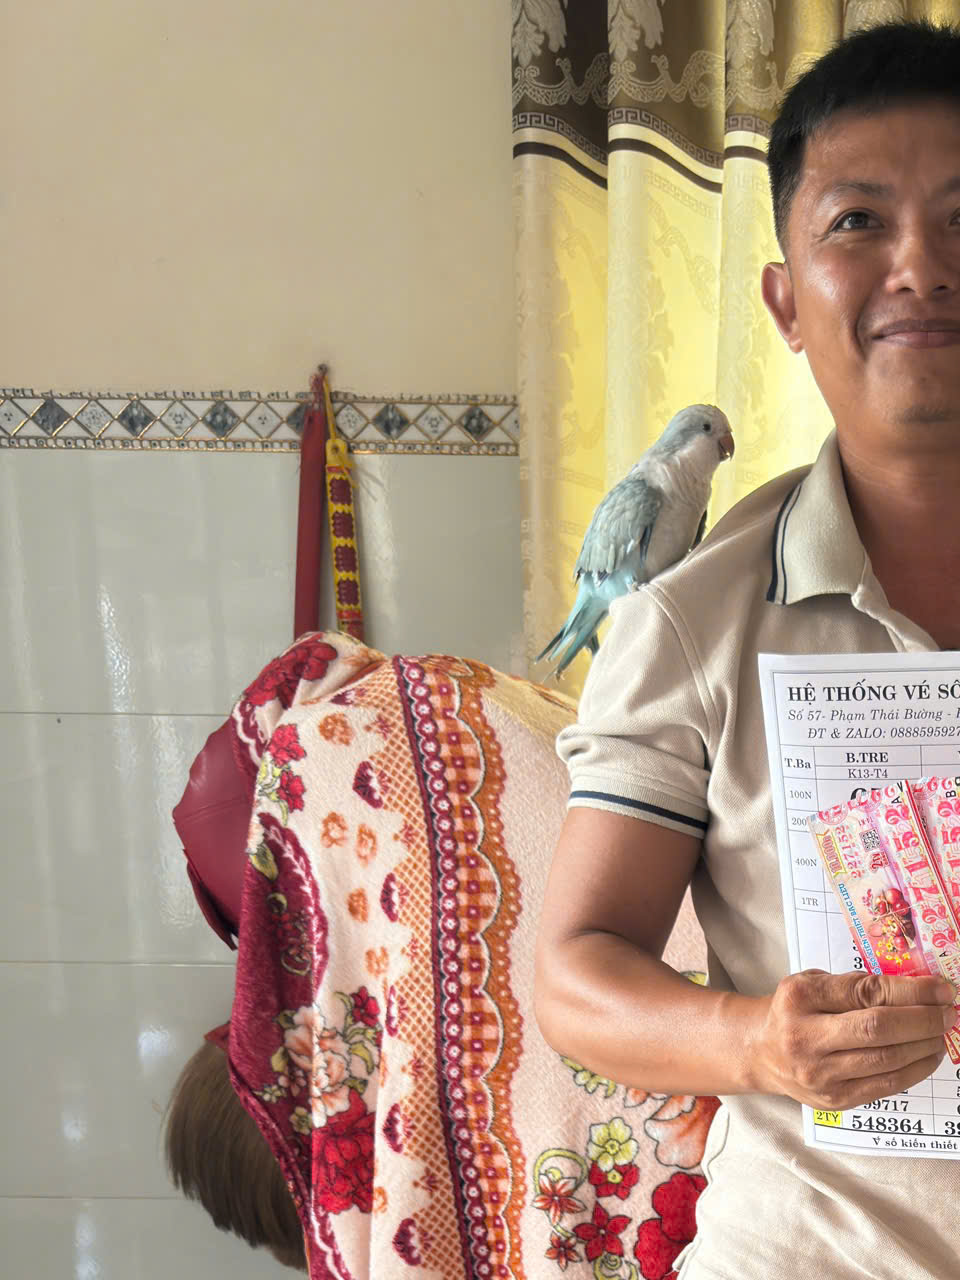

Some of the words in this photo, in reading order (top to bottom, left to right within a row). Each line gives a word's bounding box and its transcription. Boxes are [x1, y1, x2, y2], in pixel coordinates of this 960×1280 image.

[788, 683, 816, 705] HỆ
[823, 679, 896, 701] THỐNG
[903, 680, 930, 699] VÉ
[788, 709, 803, 721] Số
[830, 709, 865, 723] Phạm
[870, 709, 899, 721] Thái
[904, 708, 943, 722] Bường
[807, 728, 826, 739] ĐT
[831, 728, 841, 739] &
[846, 728, 886, 739] ZALO:
[846, 752, 889, 763] B.TRE
[784, 758, 811, 769] T.Ba
[848, 769, 889, 779] K13-T4
[789, 790, 812, 799] 100N
[944, 789, 956, 798] B
[889, 795, 901, 806] A
[791, 817, 807, 826] 200
[795, 858, 817, 867] 400N
[801, 897, 819, 906] 1TR
[852, 1115, 924, 1134] 548364
[885, 1138, 897, 1147] số
[901, 1138, 926, 1149] kiến
[930, 1139, 958, 1150] thiết
